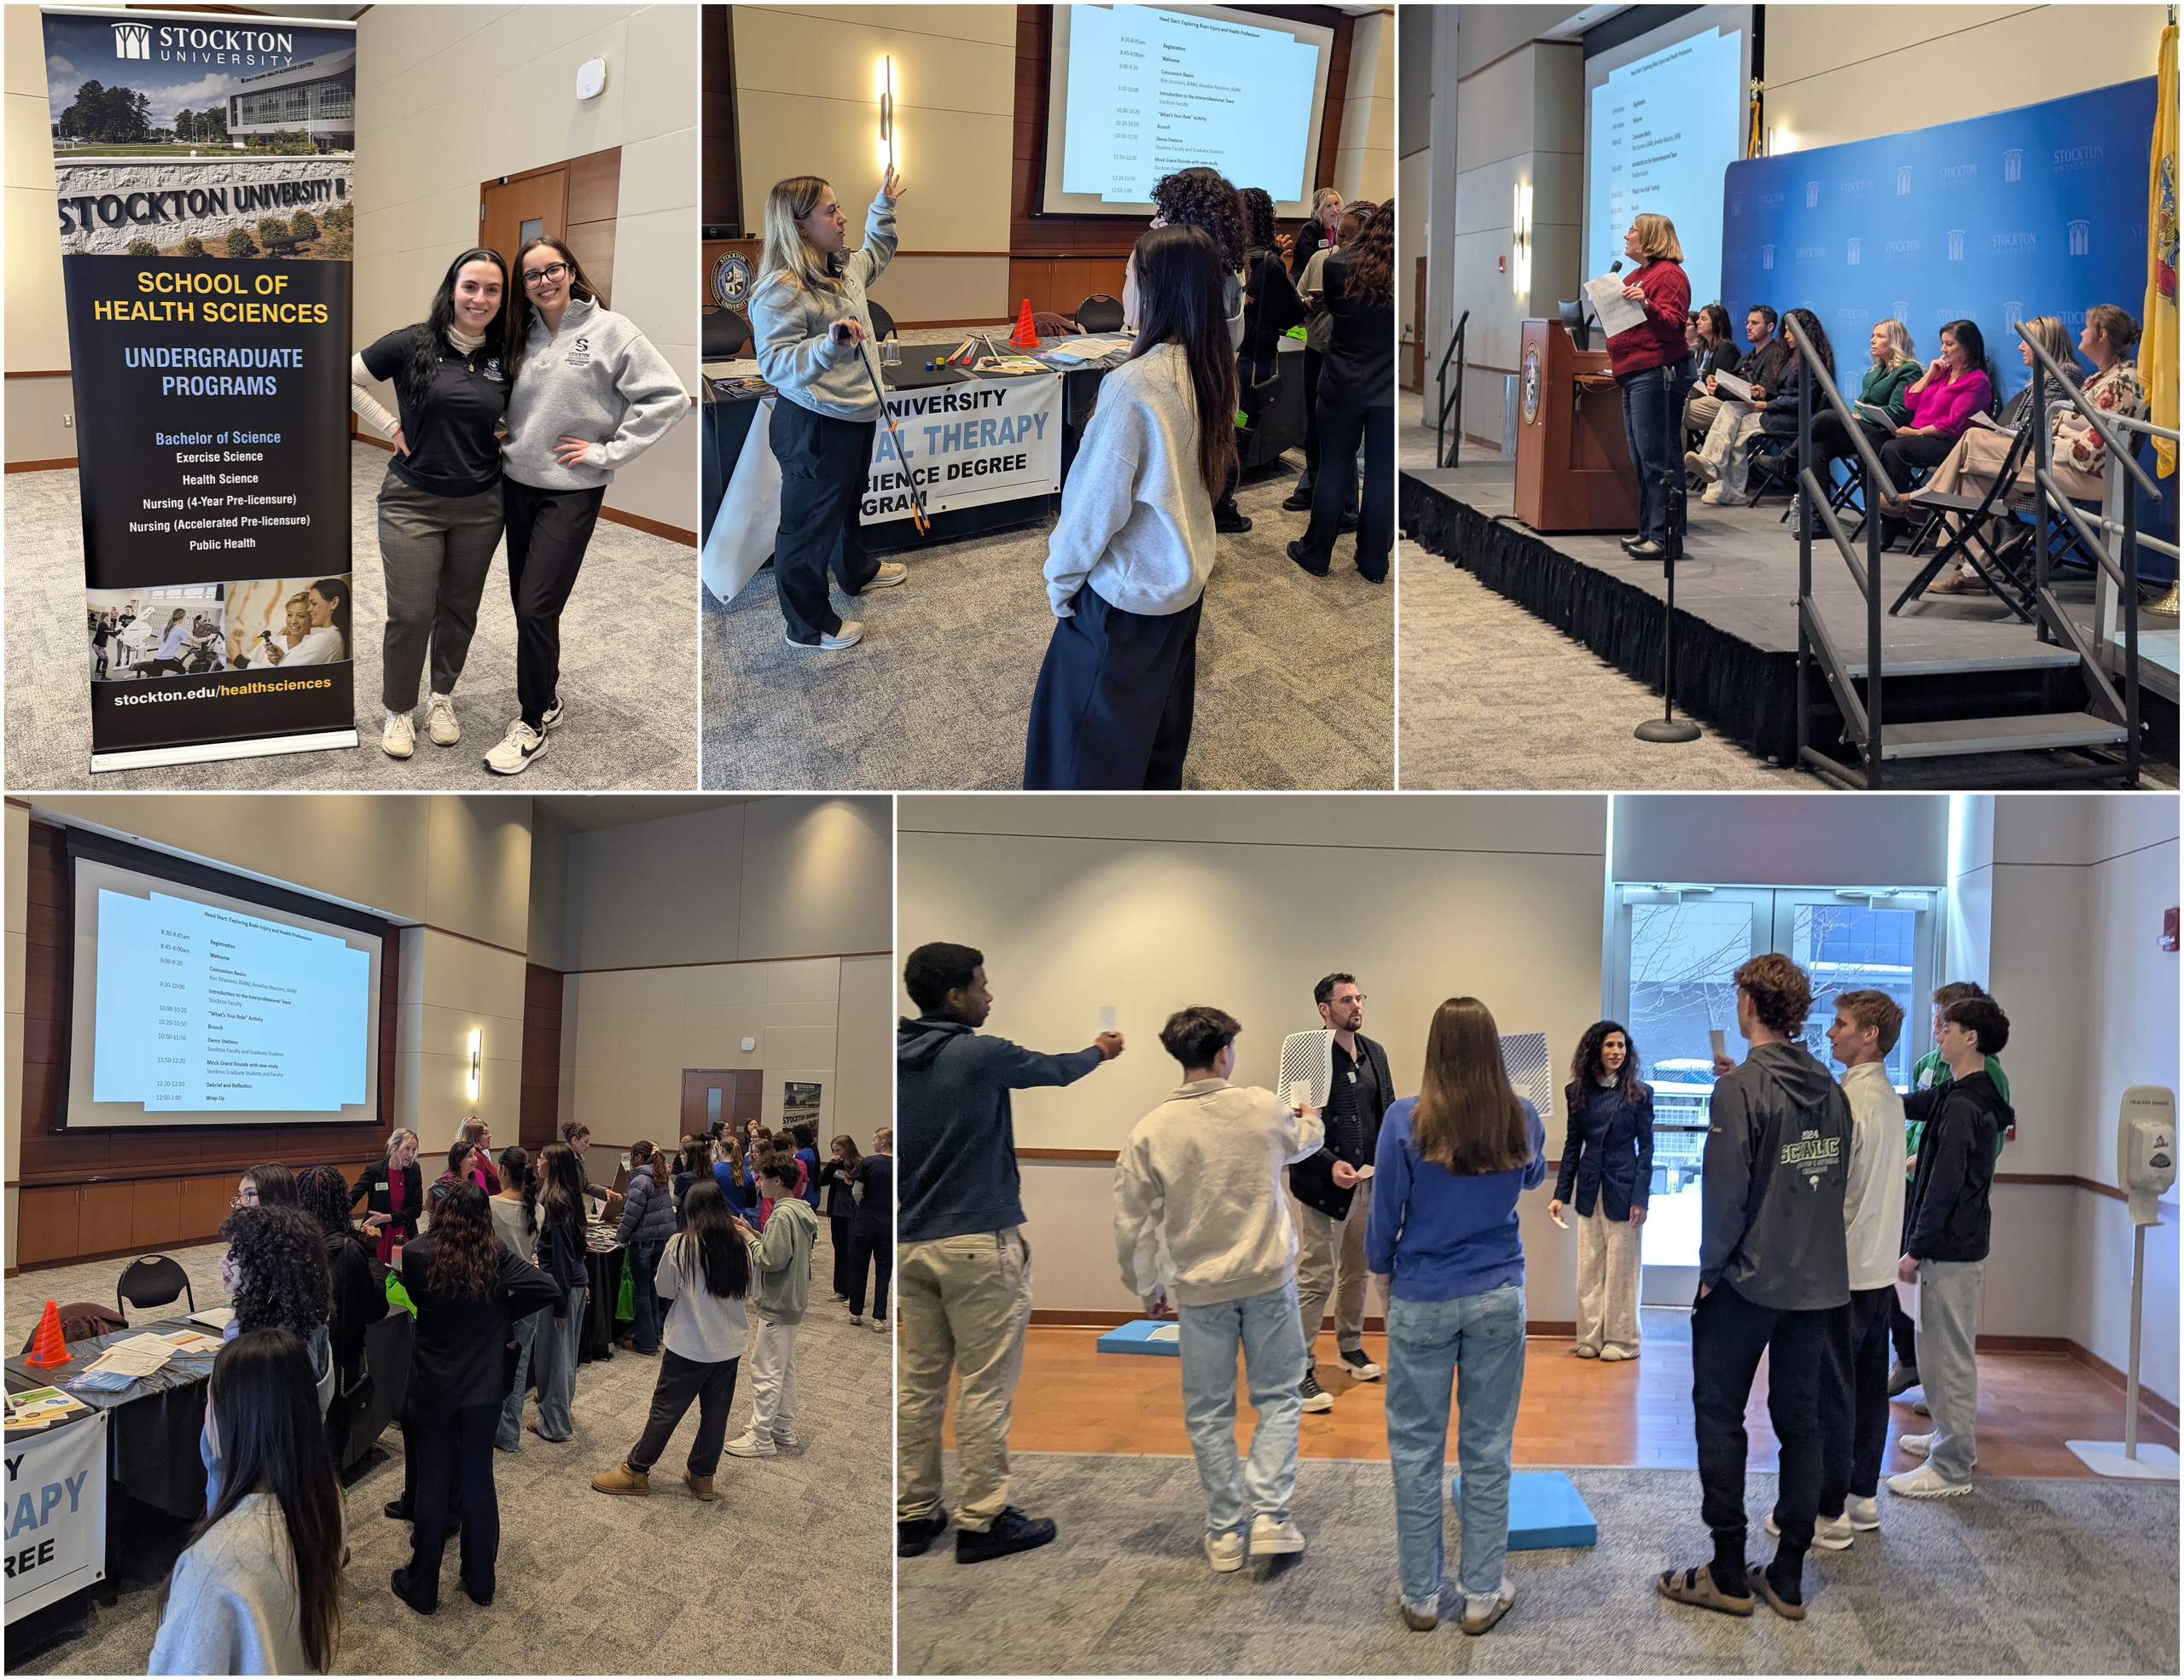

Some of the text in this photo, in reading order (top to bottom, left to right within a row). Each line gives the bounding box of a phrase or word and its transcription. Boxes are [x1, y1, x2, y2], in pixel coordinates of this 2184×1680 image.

[160, 26, 293, 53] STOCKTON
[160, 50, 293, 67] UNIVERSITY
[2054, 145, 2104, 164] STOCKTON
[1938, 165, 1978, 179] STOCKTON
[58, 179, 331, 233] STOCKTON UNIVERSITY
[1885, 240, 1921, 253] STOCKTON
[1993, 232, 2036, 247] STOCKTON
[720, 253, 746, 264] STOCKTON
[138, 272, 288, 295] SCHOOL OF
[95, 300, 328, 323] HEALTH SCIENCES
[125, 347, 303, 368] UNDERGRADUATE
[162, 375, 277, 396] PROGRAMS
[880, 389, 1007, 418] NIVERSITY
[156, 432, 281, 445] Bachelor of Science
[923, 411, 1049, 456] THERAPY
[177, 451, 263, 463] Exercise Science
[947, 454, 1027, 480] DEGREE
[183, 474, 258, 485] Health Science
[143, 493, 297, 511] Nursing (4-Year Pre-licensure)
[130, 514, 311, 534] Nursing (Accelerated Pre-licensure)
[190, 538, 256, 551] Public Health
[114, 677, 331, 706] stockton.edu/healthsciences
[205, 911, 217, 920] Head
[229, 916, 248, 927] Exploring
[210, 939, 235, 949] Registration
[210, 952, 230, 961] Welcome
